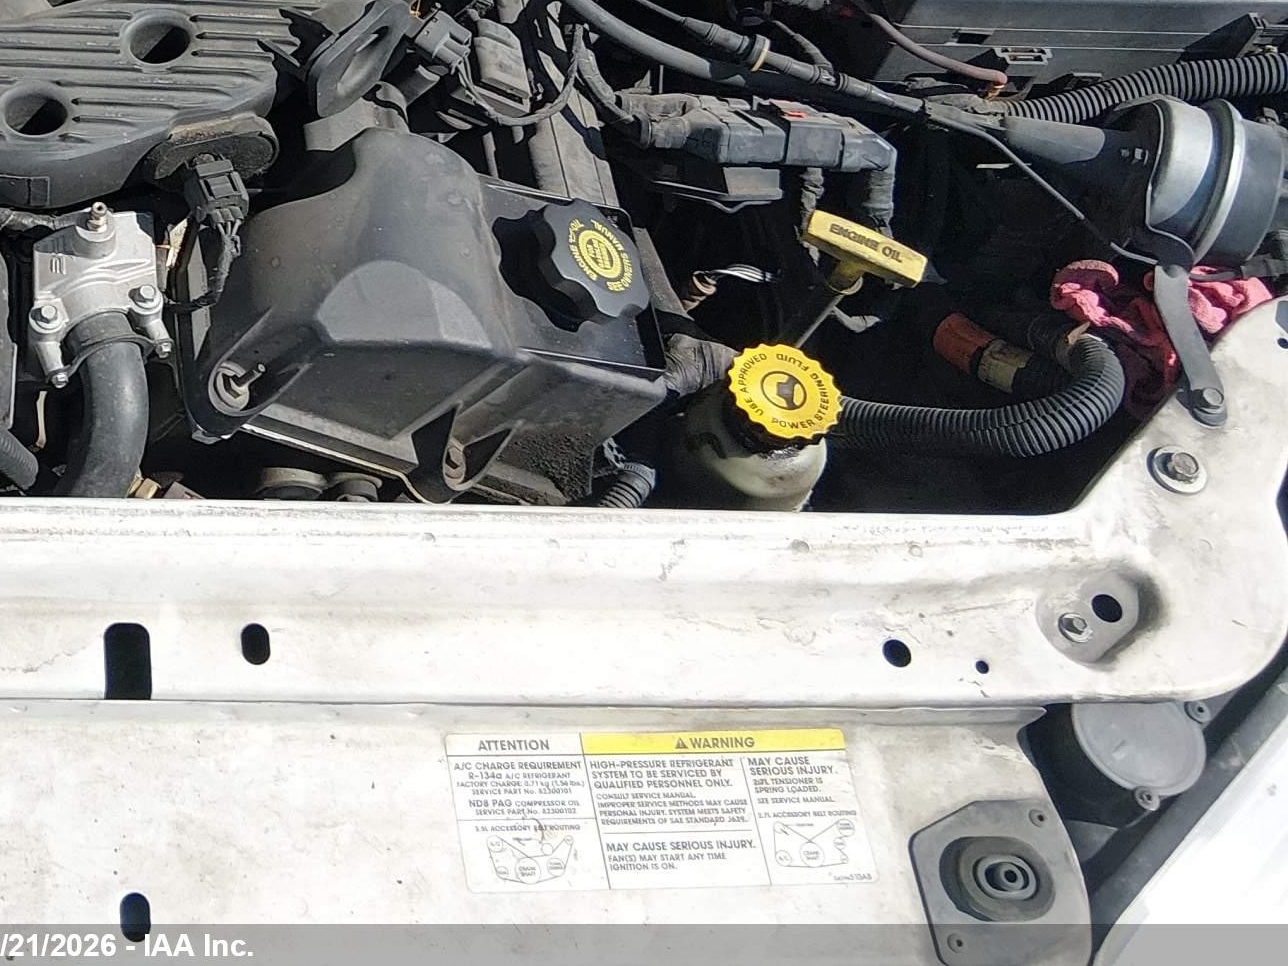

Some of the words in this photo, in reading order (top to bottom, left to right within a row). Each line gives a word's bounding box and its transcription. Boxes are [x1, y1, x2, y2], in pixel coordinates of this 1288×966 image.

[590, 218, 625, 252] MANUAL
[829, 222, 879, 252] ENGINE
[881, 246, 903, 263] OIL
[775, 352, 810, 372] FLUID
[738, 352, 768, 394] APPROVED
[810, 372, 830, 422] STEERING
[744, 396, 764, 416] USE
[772, 416, 815, 430] POWER
[478, 739, 550, 751] ATTENTION
[689, 736, 756, 750] WARNING
[454, 763, 472, 771] A/C
[475, 762, 516, 771] CHARGE
[518, 761, 581, 770] REQUIREMENT
[590, 760, 667, 770] HIGH-PRESSURE
[669, 758, 733, 768] REFRIGERANT
[748, 756, 772, 766] MAY
[774, 756, 810, 765] CAUSE
[468, 771, 502, 780] R-134a
[522, 771, 571, 779] REFRIGERANT
[592, 770, 628, 779] SYSTEM
[631, 770, 643, 778] TO
[646, 769, 659, 778] BE
[661, 768, 707, 777] SERVICED
[710, 767, 722, 776] BY
[750, 766, 794, 776] SERIOUS
[594, 780, 644, 790] QUALIFIED
[646, 779, 702, 789] PERSONNEL
[705, 778, 733, 787] ONLY.
[772, 777, 813, 785] TENSIONER
[754, 786, 785, 794] SPRING
[787, 785, 821, 793] LOADED.
[596, 792, 629, 800] CONSULT
[632, 791, 661, 799] SERVICE
[757, 796, 769, 804] SEE
[771, 795, 801, 804] SERVICE
[469, 799, 489, 808] ND8
[492, 799, 513, 807] PAG
[514, 799, 563, 807] COMPRESSOR
[597, 801, 635, 809] IMPROPER
[637, 800, 668, 808] SERVICE
[670, 799, 704, 807] METHODS
[706, 798, 722, 806] MAY
[475, 808, 505, 816] SERVICE
[599, 809, 637, 818] PERSONAL
[669, 808, 694, 816] SYSTEM
[697, 807, 720, 815] MEETS
[722, 807, 746, 815] SAFETY
[773, 810, 811, 818] ACCESSORY
[601, 818, 656, 826] REQUIREMENTS
[686, 815, 725, 824] STANDARD
[491, 824, 531, 832] ACCESSORY
[549, 823, 581, 831] ROUTING
[607, 842, 629, 851] MAY
[633, 841, 668, 851] CAUSE
[670, 840, 713, 850] SERIOUS
[715, 838, 755, 849] INJURY.
[608, 853, 637, 862] FAN(S)
[640, 853, 658, 861] MAY
[660, 852, 684, 860] START
[688, 852, 704, 860] ANY
[708, 851, 726, 859] TIME
[609, 862, 649, 871] IGNITION
[652, 862, 660, 870] IS
